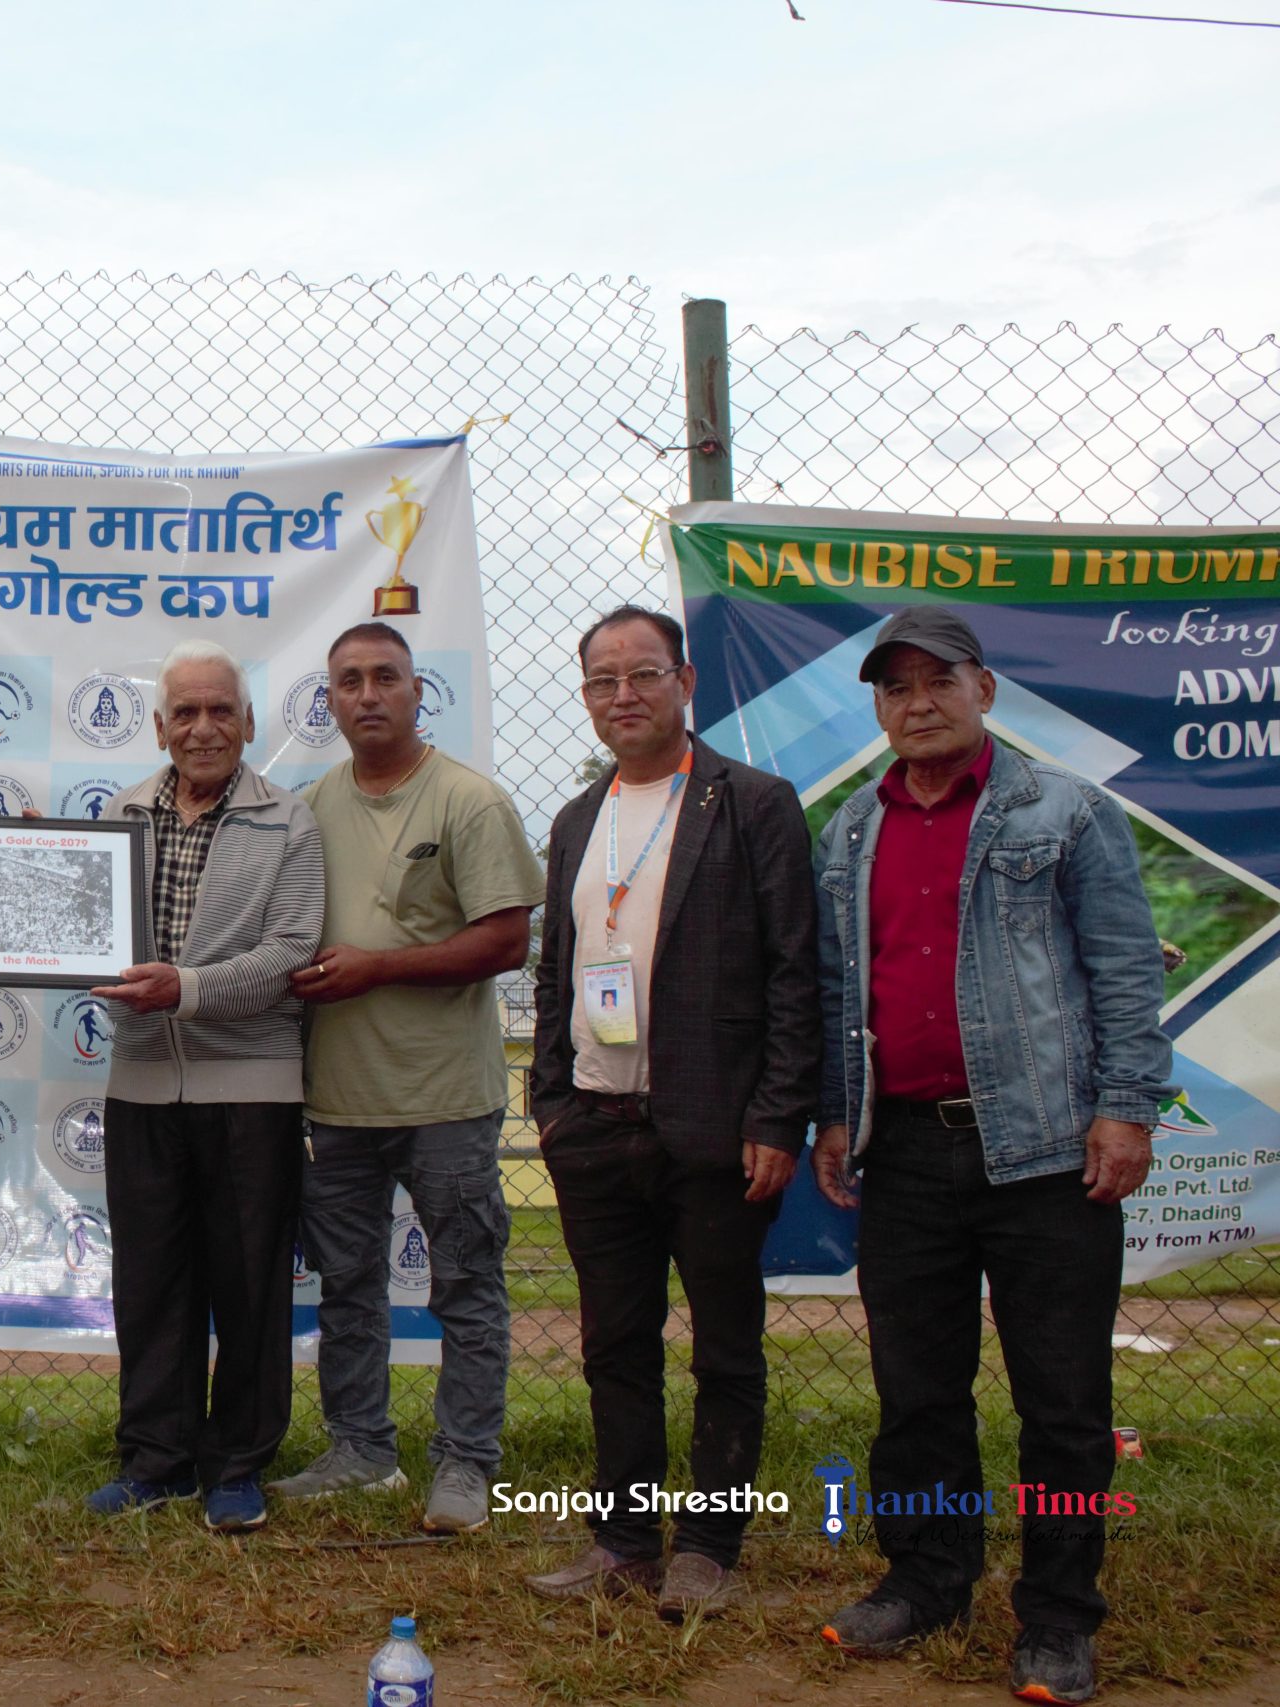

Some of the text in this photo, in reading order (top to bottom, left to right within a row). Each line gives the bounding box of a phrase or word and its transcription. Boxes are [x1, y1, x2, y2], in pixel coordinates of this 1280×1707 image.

[27, 462, 48, 477] FOR
[51, 463, 96, 479] HEALTH,
[87, 491, 344, 555] मातातिर्थ
[726, 540, 1017, 589] NAUBISE
[158, 574, 274, 618] कप
[1101, 606, 1279, 657] looking
[6, 836, 32, 846] Gold
[36, 837, 89, 848] Cup-2079
[3, 955, 22, 965] the
[25, 956, 60, 966] Match
[1170, 1151, 1247, 1173] Organic
[1175, 1178, 1212, 1196] Pvt.
[1219, 1177, 1252, 1194] Ltd.
[1162, 1205, 1242, 1222] Dhading
[1155, 1232, 1202, 1248] from
[1208, 1226, 1256, 1245] KTM)
